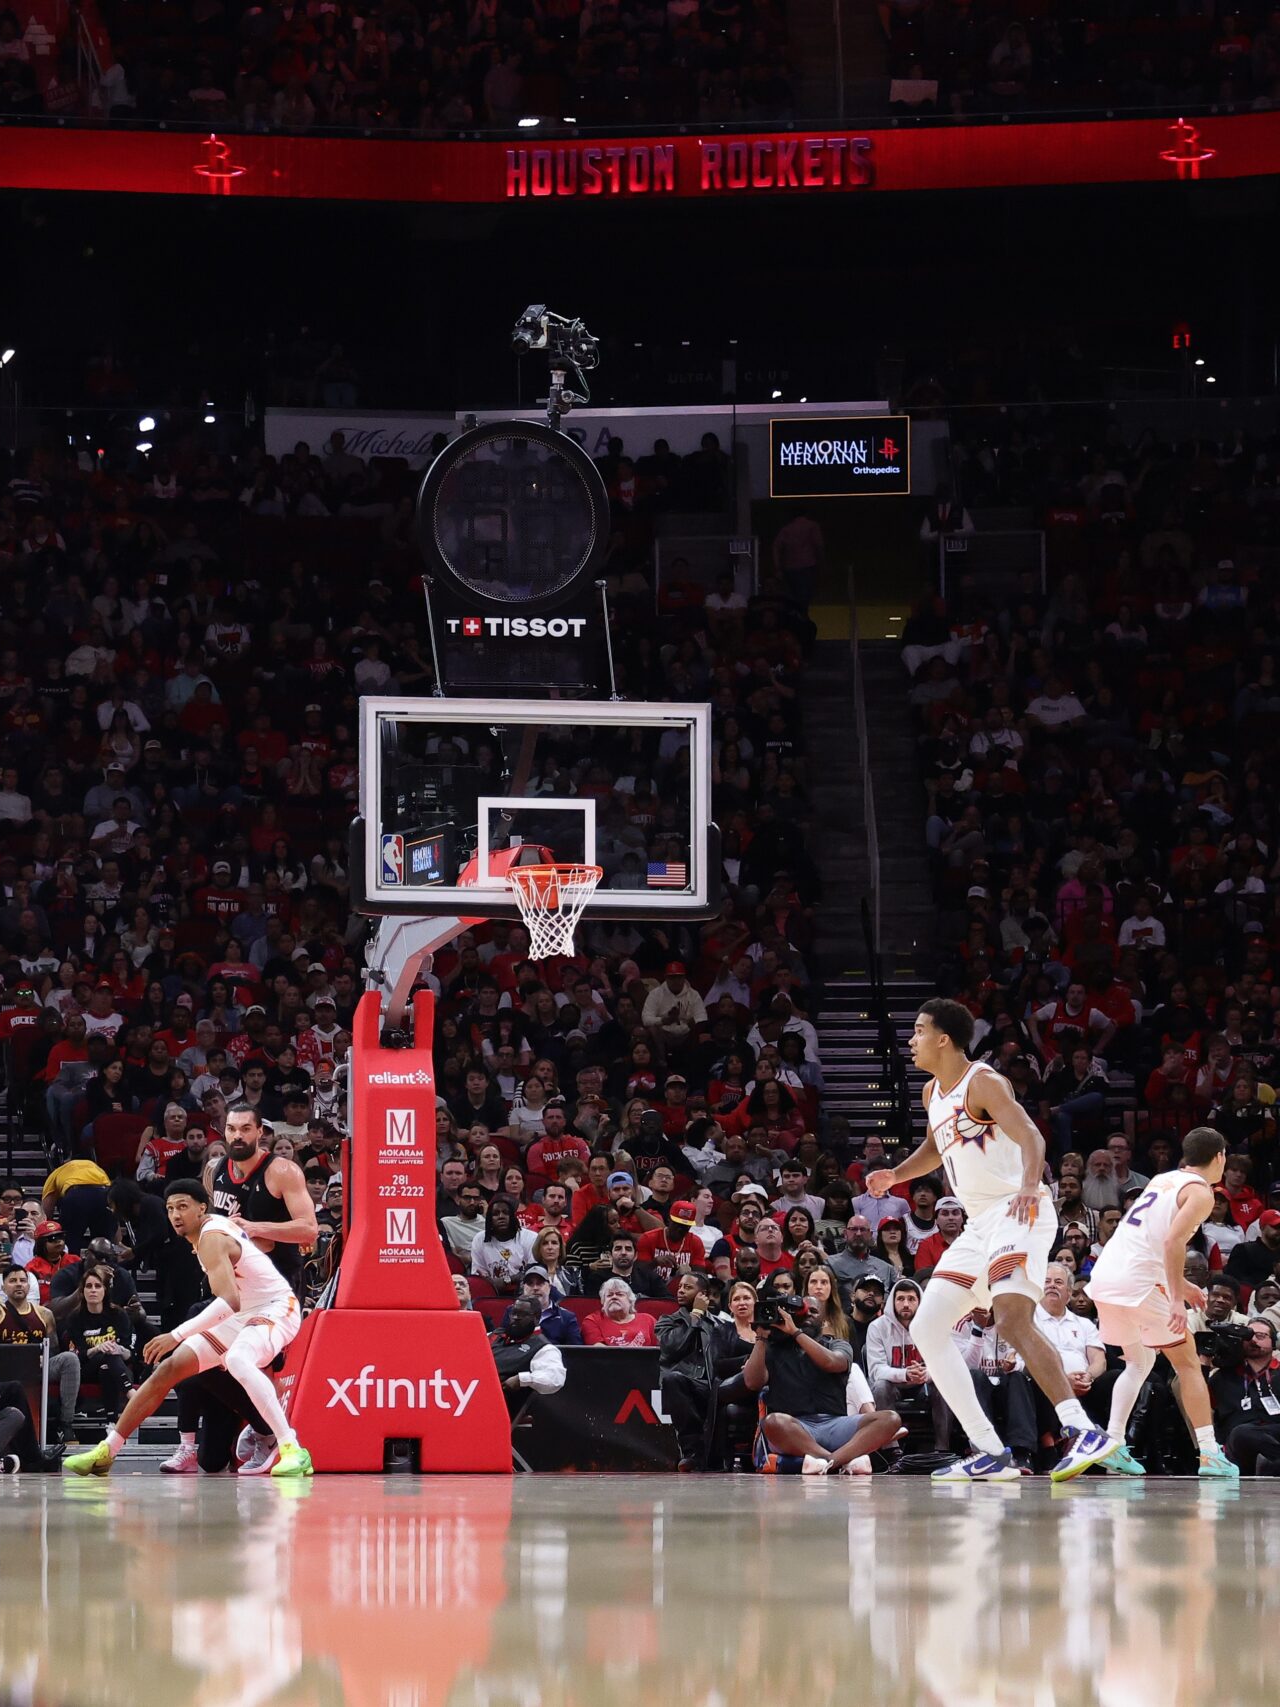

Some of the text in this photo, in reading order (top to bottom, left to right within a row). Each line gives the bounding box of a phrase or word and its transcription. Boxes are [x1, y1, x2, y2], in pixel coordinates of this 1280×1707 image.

[506, 137, 872, 197] HOUSTON ROCKETS
[780, 440, 867, 455] MEMORIAL
[780, 450, 867, 466] HERMANN
[853, 466, 900, 475] Orthopedics
[484, 617, 587, 638] TISSOT
[368, 1072, 416, 1085] reliant
[389, 1111, 412, 1143] M
[378, 1149, 424, 1157] MOKARAM
[392, 1175, 409, 1185] 281
[378, 1186, 424, 1197] 222-2222
[389, 1210, 413, 1243] M
[378, 1248, 425, 1256] MOKARAM
[325, 1365, 480, 1416] xfinity
